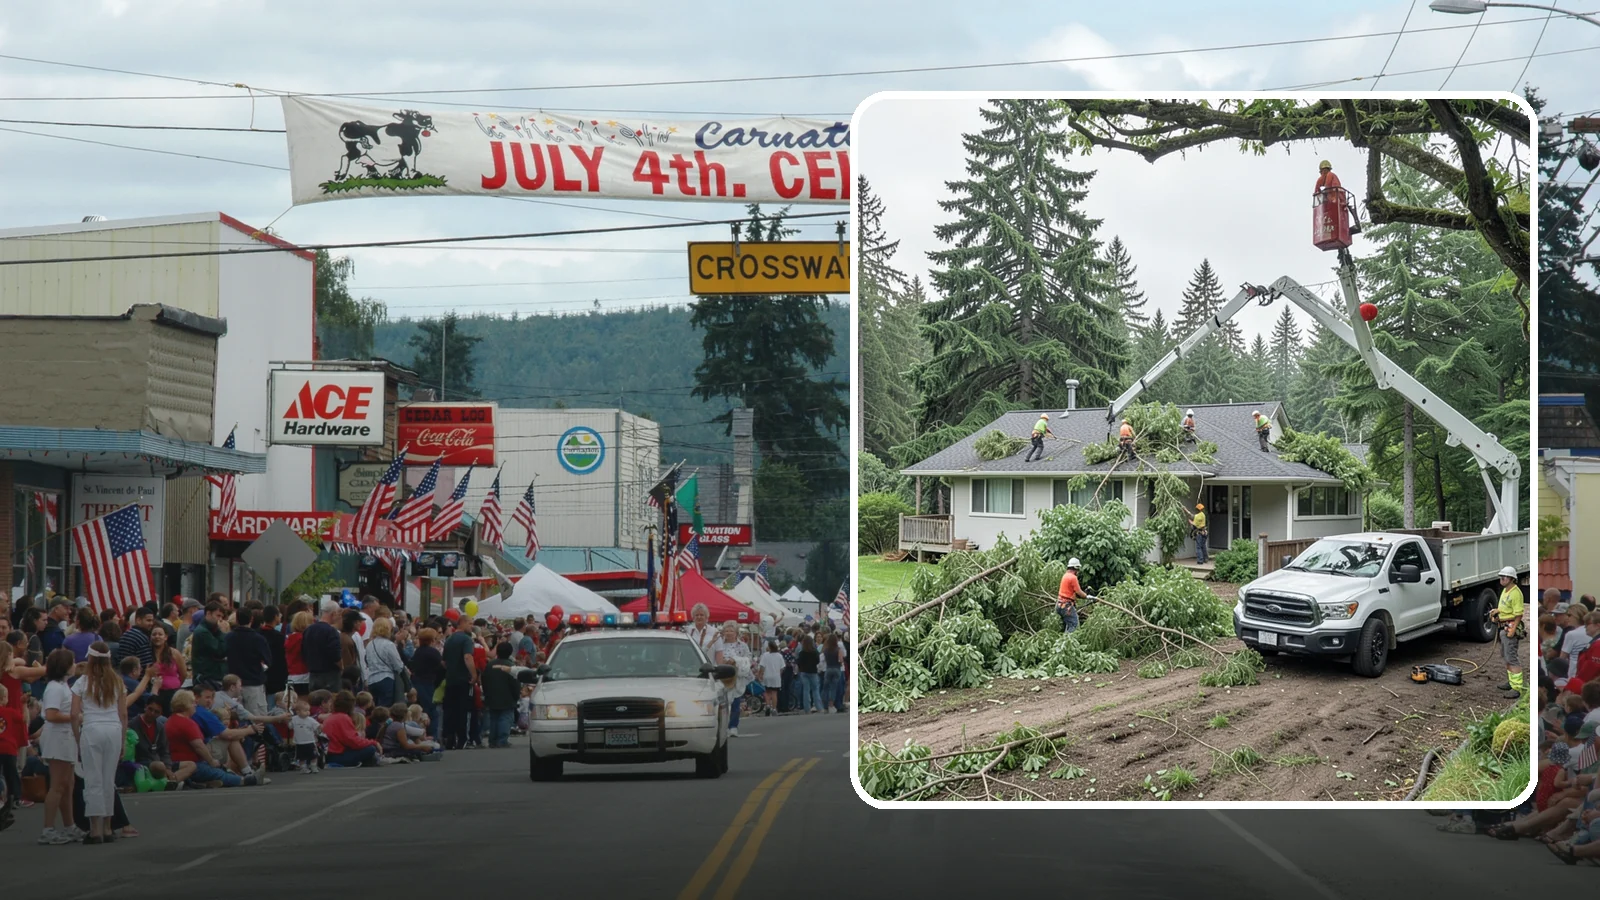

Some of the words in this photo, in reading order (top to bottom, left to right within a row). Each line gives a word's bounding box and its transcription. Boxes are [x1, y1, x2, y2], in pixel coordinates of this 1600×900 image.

[481, 140, 605, 193] JULY
[632, 149, 746, 198] 4th.
[697, 254, 850, 280] CROSSWA
[283, 380, 373, 420] ACE
[406, 409, 452, 422] CEDAR
[284, 421, 370, 436] Hardware
[416, 428, 476, 446] Coca-Cola
[96, 485, 124, 495] Vincent
[126, 487, 136, 495] de
[138, 486, 155, 496] Paul
[688, 527, 741, 535] CRNATION
